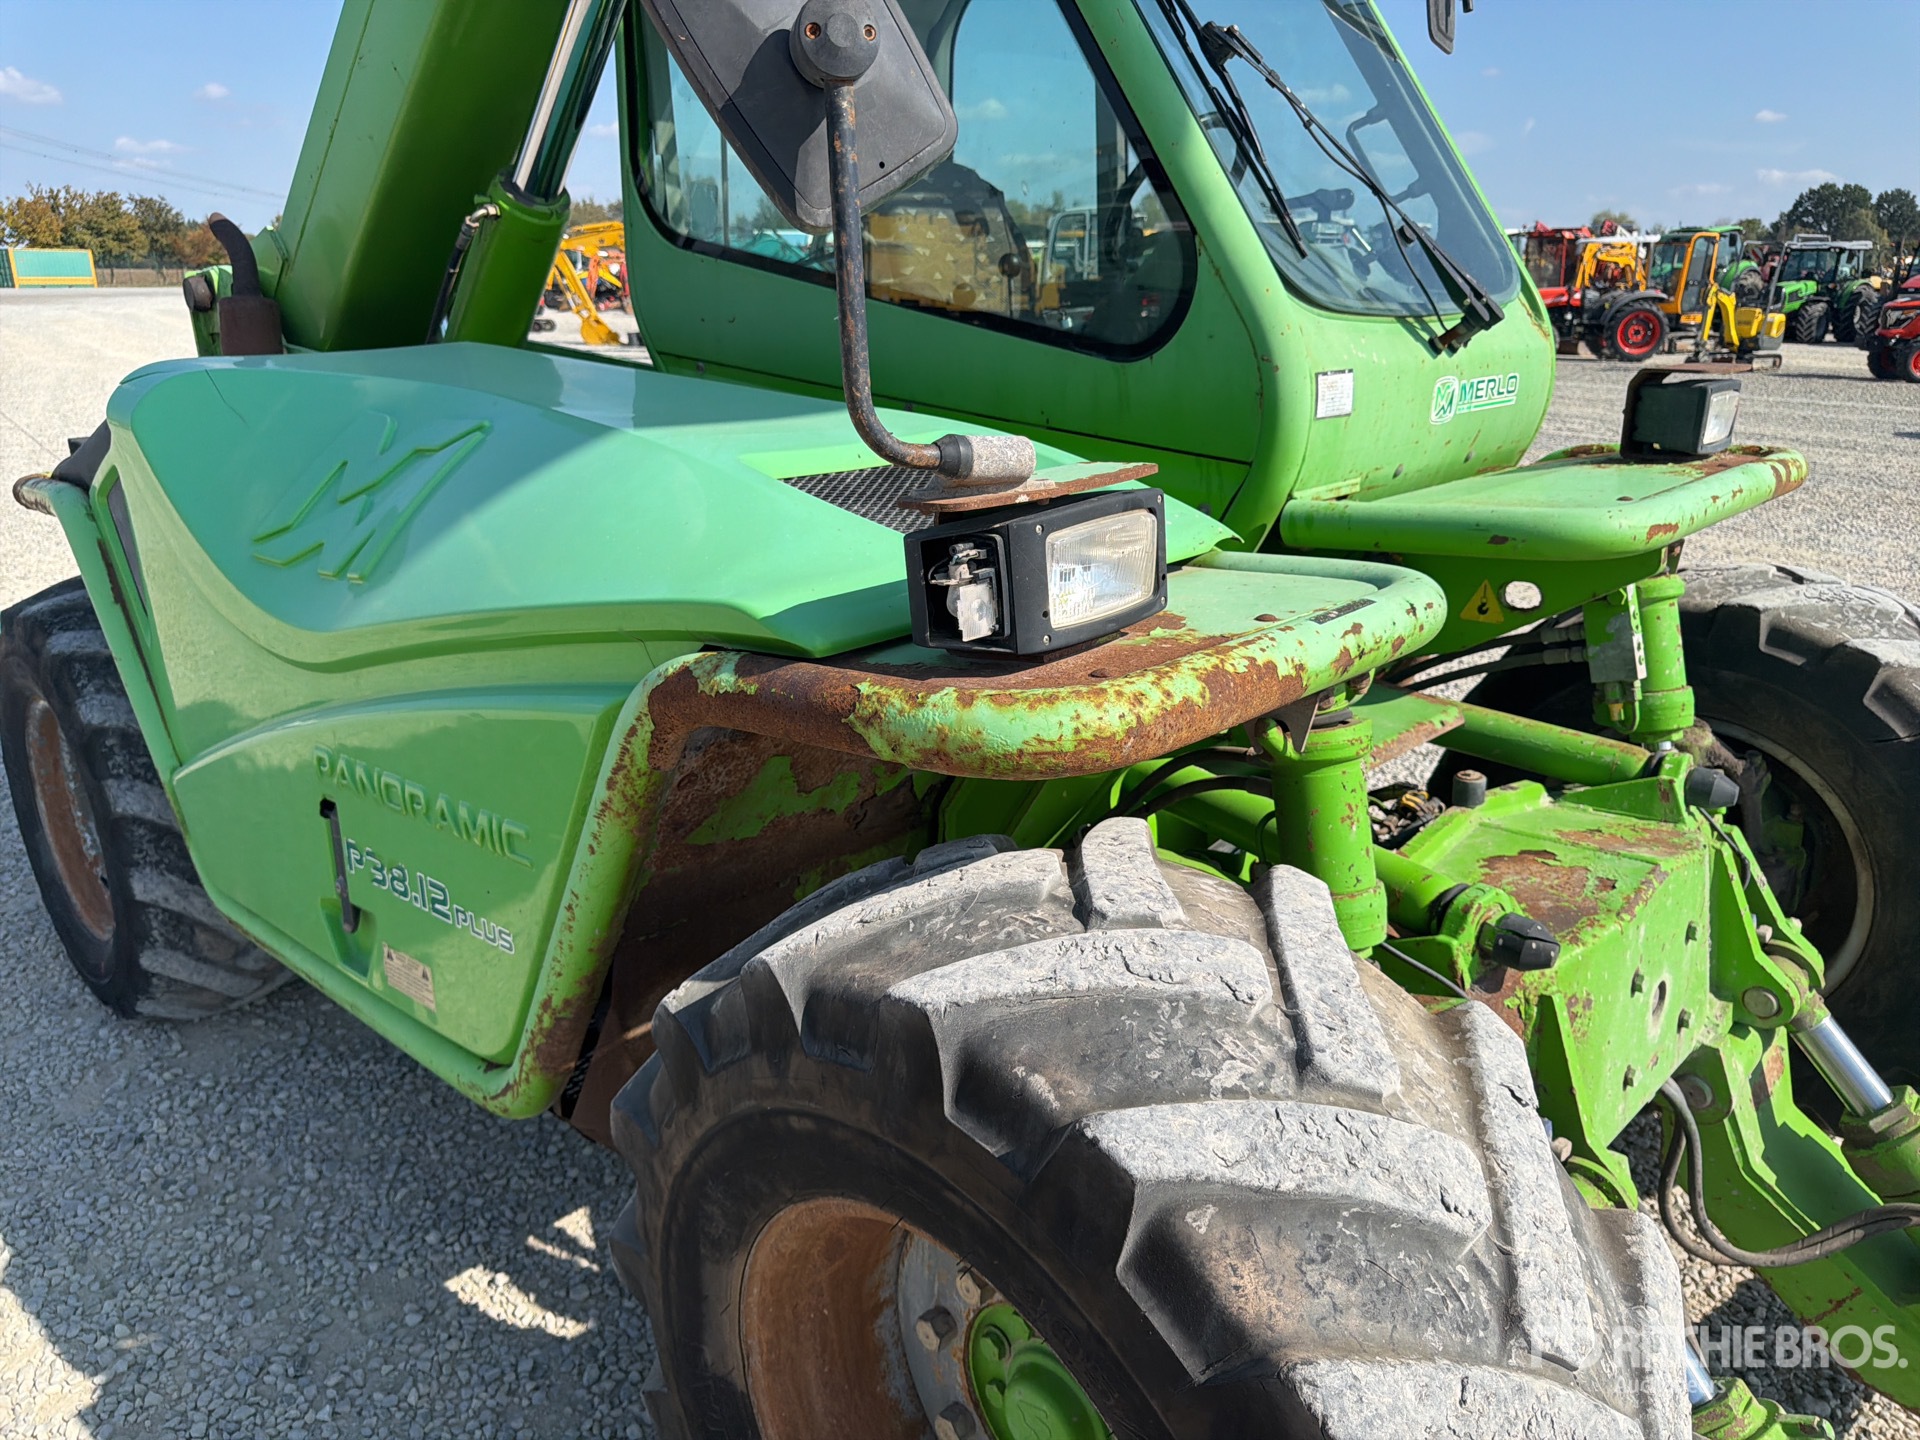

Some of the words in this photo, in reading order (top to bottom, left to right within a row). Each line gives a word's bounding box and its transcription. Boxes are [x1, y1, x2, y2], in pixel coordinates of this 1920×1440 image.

[1459, 374, 1518, 403] MERLO
[313, 744, 535, 869] PANORAMIC
[453, 904, 515, 955] PLUS
